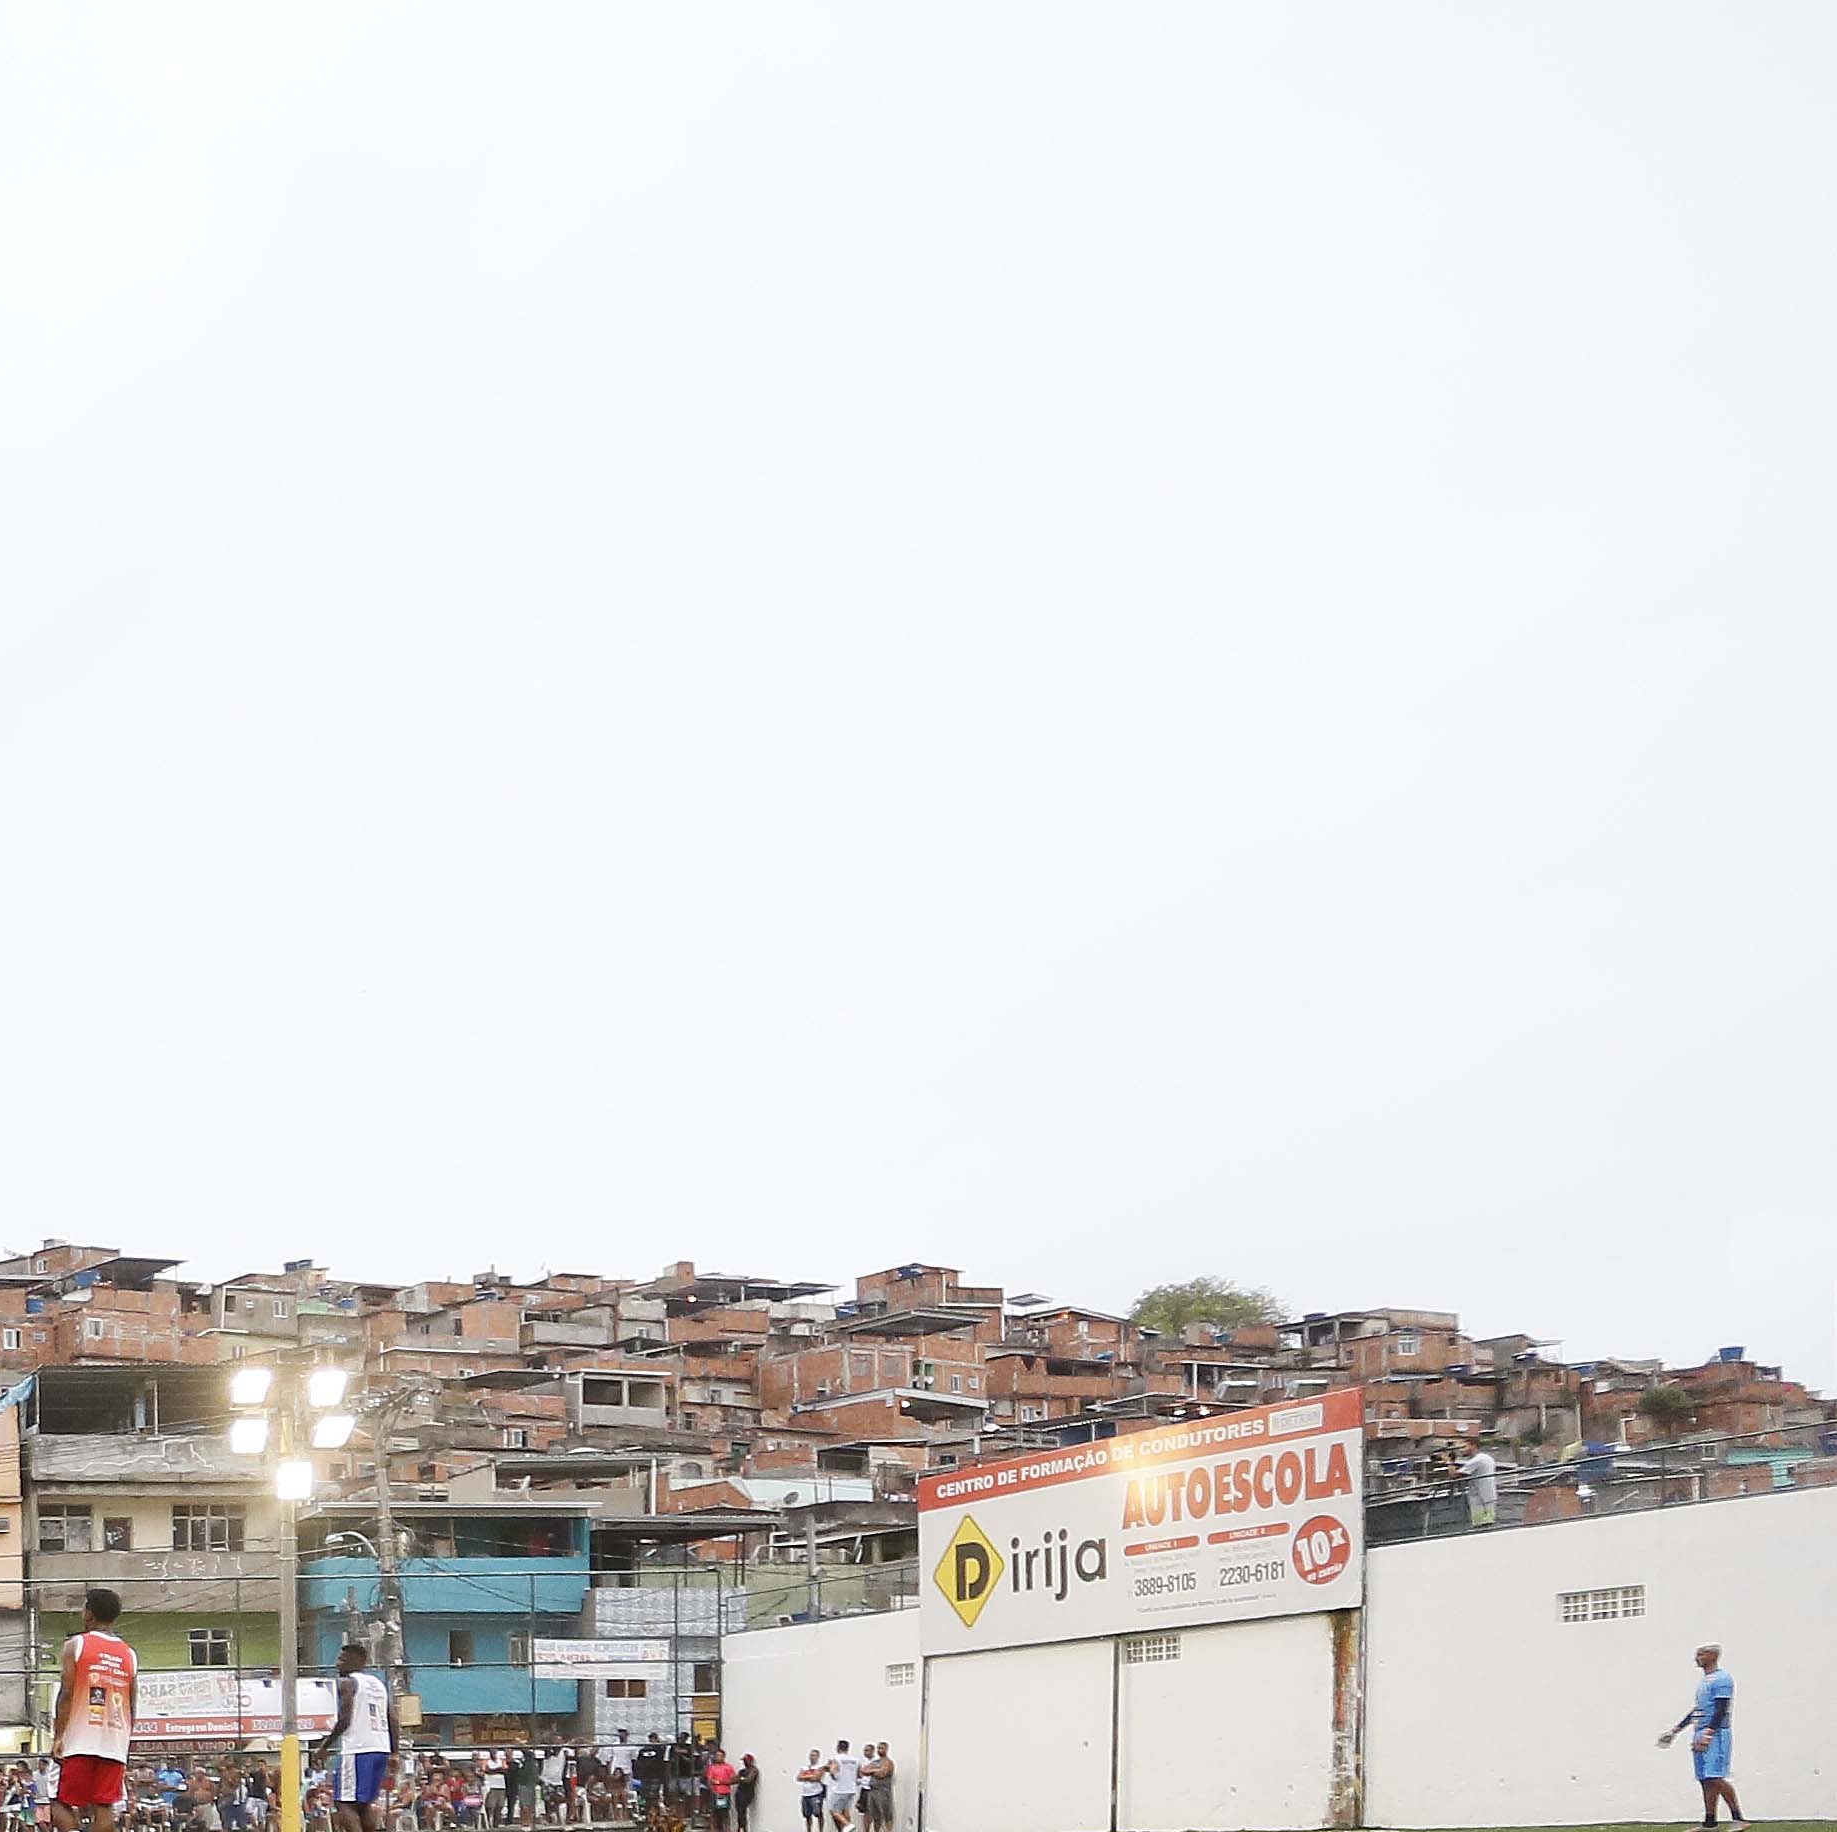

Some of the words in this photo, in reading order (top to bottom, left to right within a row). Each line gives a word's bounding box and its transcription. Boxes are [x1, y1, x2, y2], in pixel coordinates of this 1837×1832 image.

[937, 1475, 994, 1499] CENTRO
[997, 1469, 1017, 1486] DE
[1021, 1450, 1107, 1481] FORMAÇÃO
[1112, 1444, 1134, 1463] DE
[1139, 1419, 1265, 1456] CONDUTORES
[1122, 1442, 1353, 1530] AUTOESCOLA
[1134, 1572, 1196, 1598] 3889-8105
[1219, 1560, 1286, 1587] 2230-6181
[165, 1722, 196, 1735] Entrega
[136, 1741, 163, 1751] SEJA
[164, 1741, 194, 1751] BEM
[197, 1741, 236, 1751] VINDO
